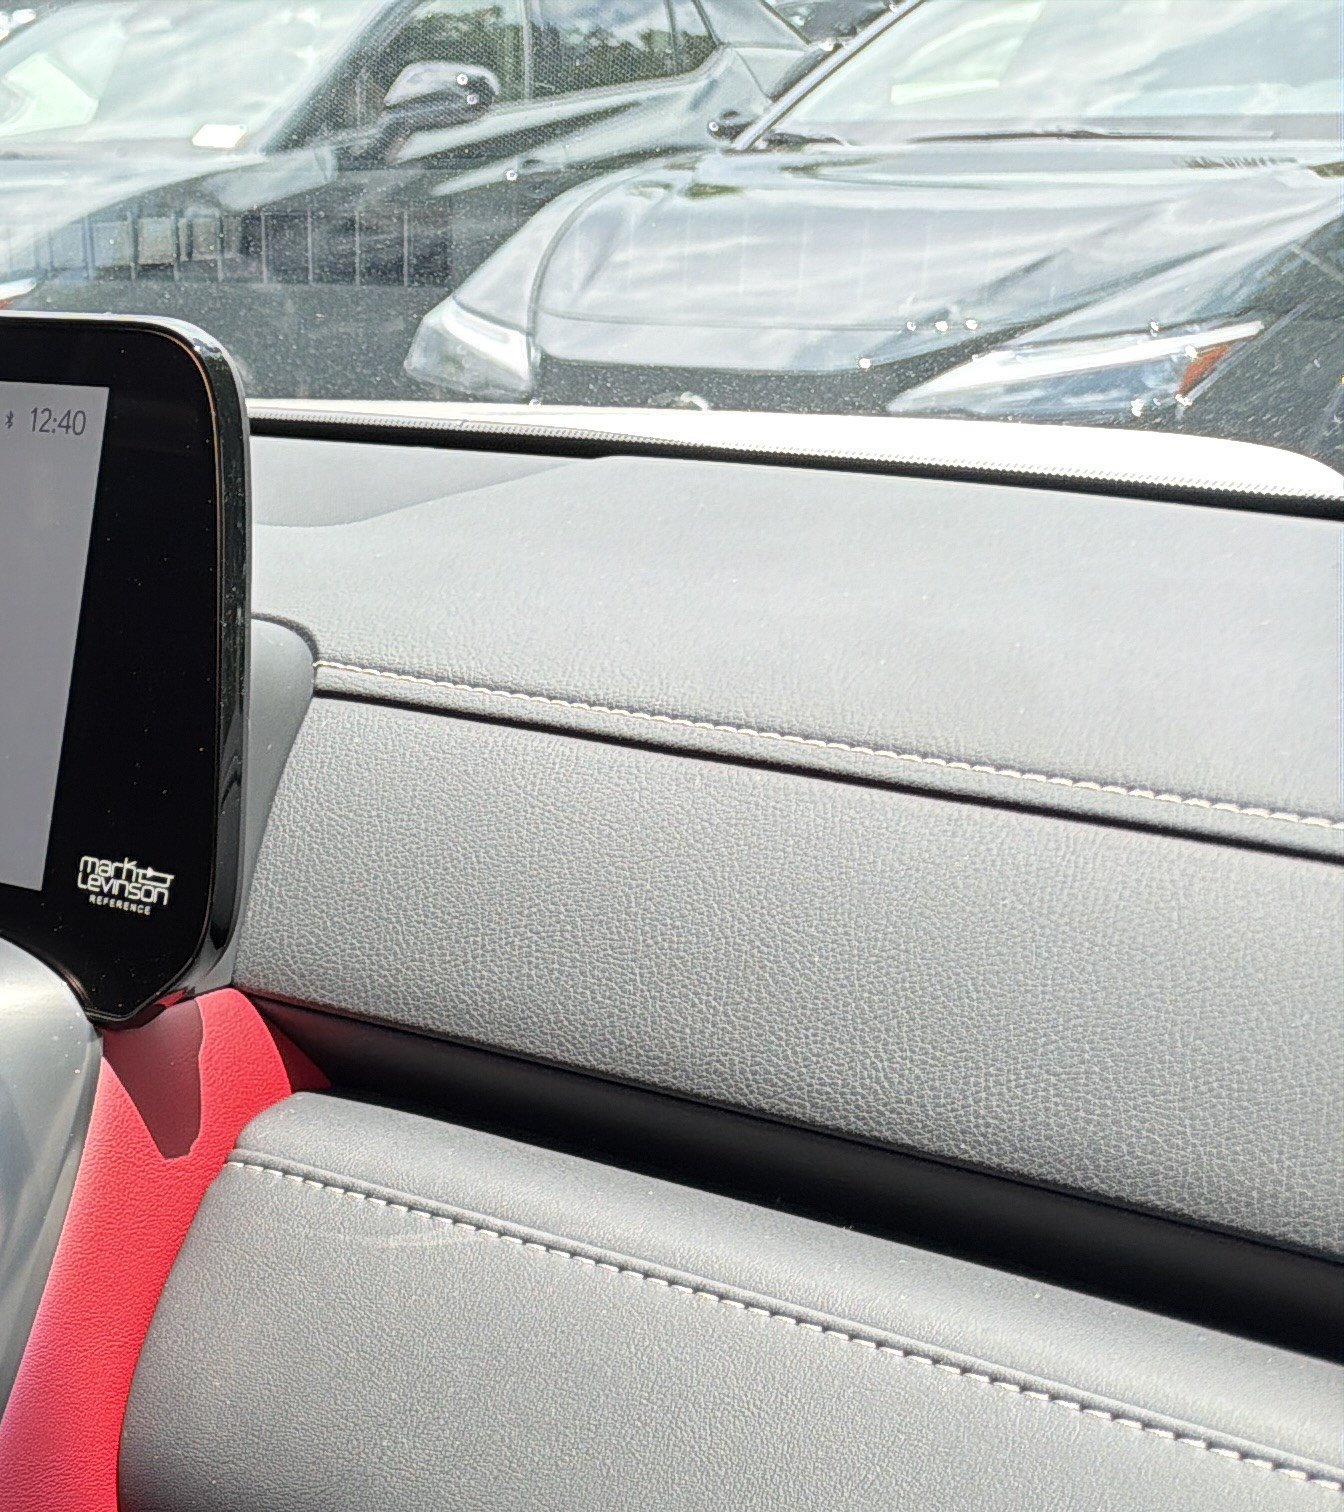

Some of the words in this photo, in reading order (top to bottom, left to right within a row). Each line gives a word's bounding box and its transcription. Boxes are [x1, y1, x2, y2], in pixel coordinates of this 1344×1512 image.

[31, 407, 86, 436] 12:40
[79, 855, 138, 883] mark
[77, 871, 170, 906] Levinson
[89, 894, 152, 916] REFERENCE
